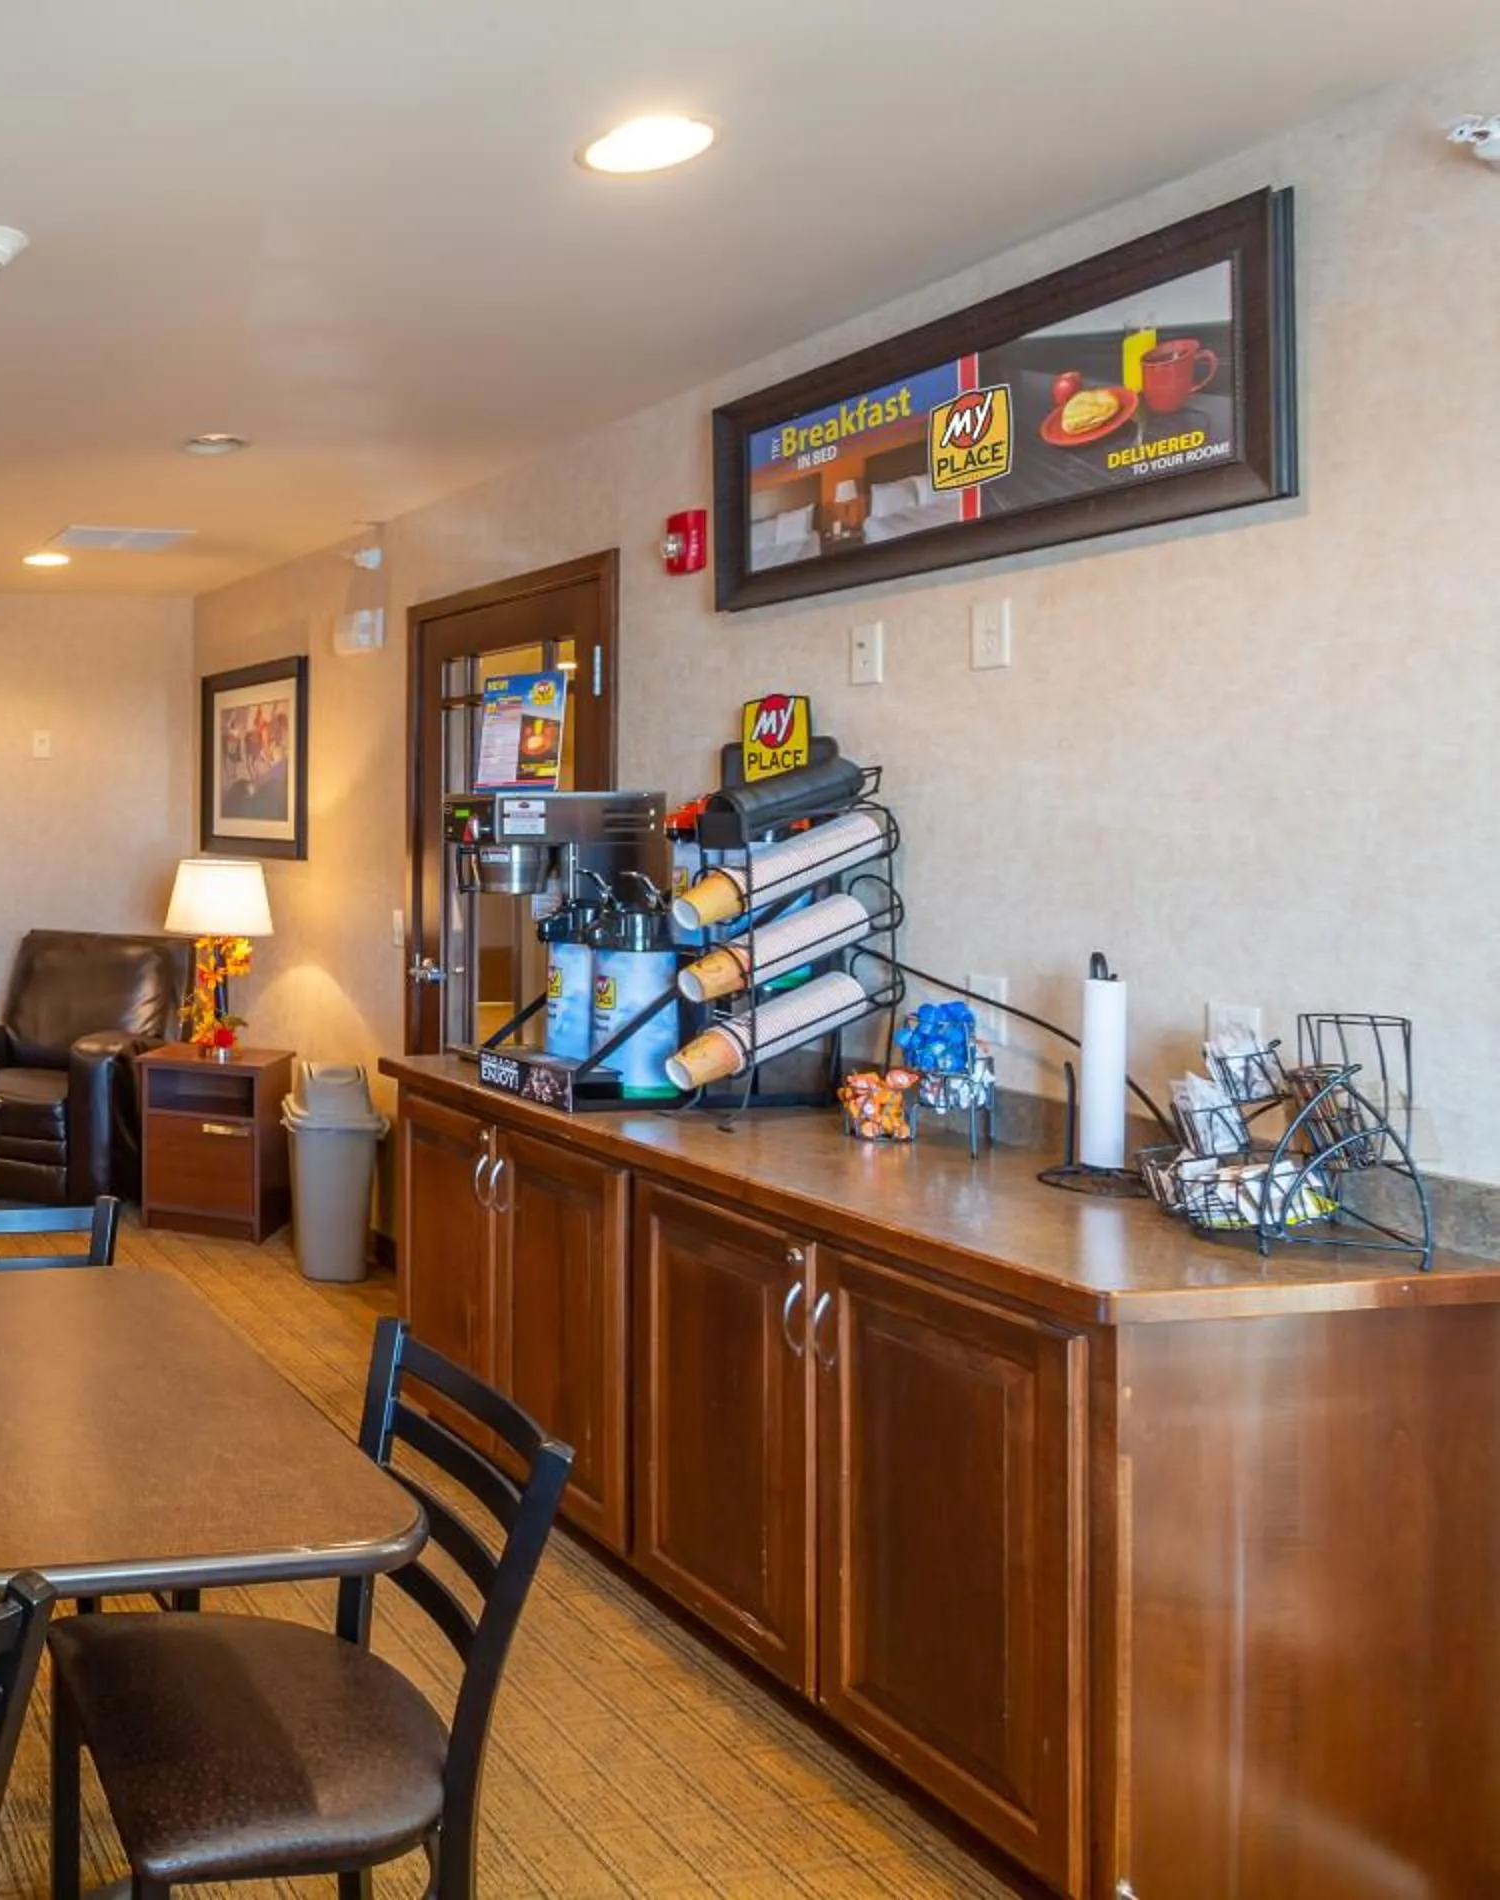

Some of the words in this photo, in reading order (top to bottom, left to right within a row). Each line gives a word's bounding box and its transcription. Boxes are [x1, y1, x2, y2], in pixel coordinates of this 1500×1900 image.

[781, 387, 912, 457] Breakfast
[797, 453, 811, 470] IN
[812, 445, 837, 465] BED
[937, 440, 1006, 478] PLACE
[1107, 431, 1205, 469] DELIVERED
[1133, 462, 1149, 476] TO
[1150, 454, 1184, 471] YOUR
[1185, 441, 1230, 462] ROOM!
[747, 750, 804, 771] PLACE
